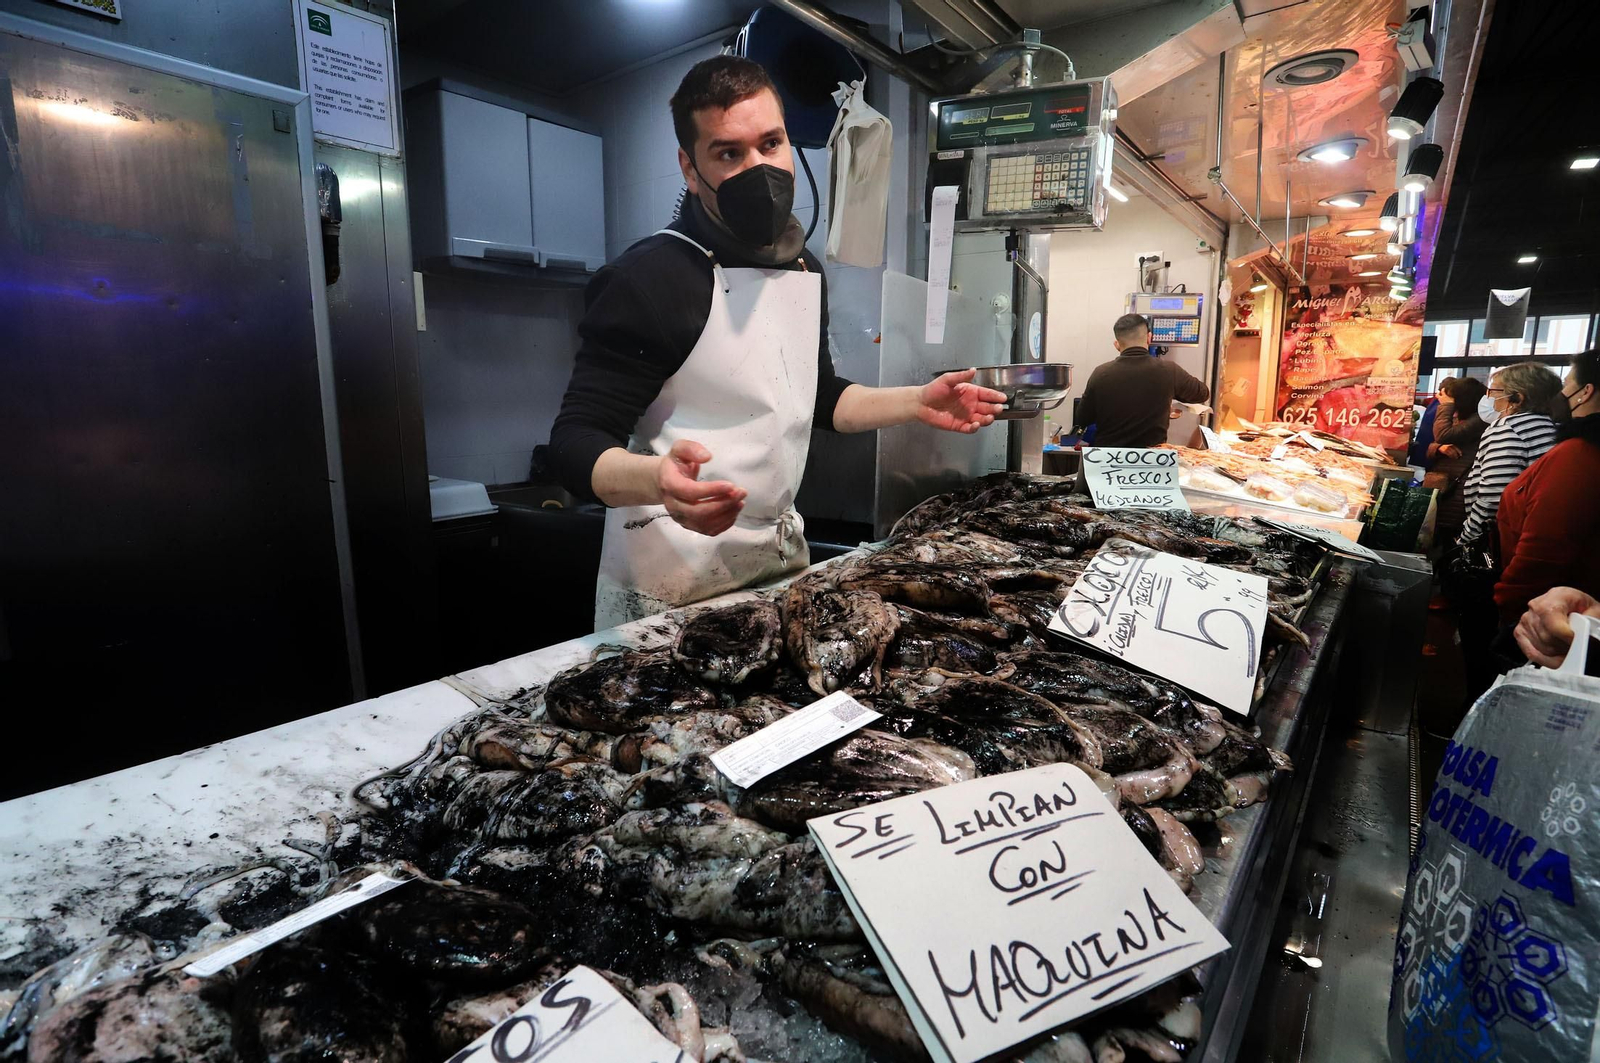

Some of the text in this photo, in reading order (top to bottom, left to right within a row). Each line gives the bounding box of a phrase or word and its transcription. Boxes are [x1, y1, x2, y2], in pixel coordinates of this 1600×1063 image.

[1050, 121, 1078, 129] MINERVA
[1282, 407, 1406, 428] 625 146 262
[1101, 469, 1173, 486] FRESCOS
[1129, 569, 1157, 608] FRESCOS
[1154, 575, 1257, 678] 5
[832, 781, 1078, 849] SE LIMPIAN
[988, 840, 1067, 893] CON
[927, 887, 1186, 1040] MAQUINA
